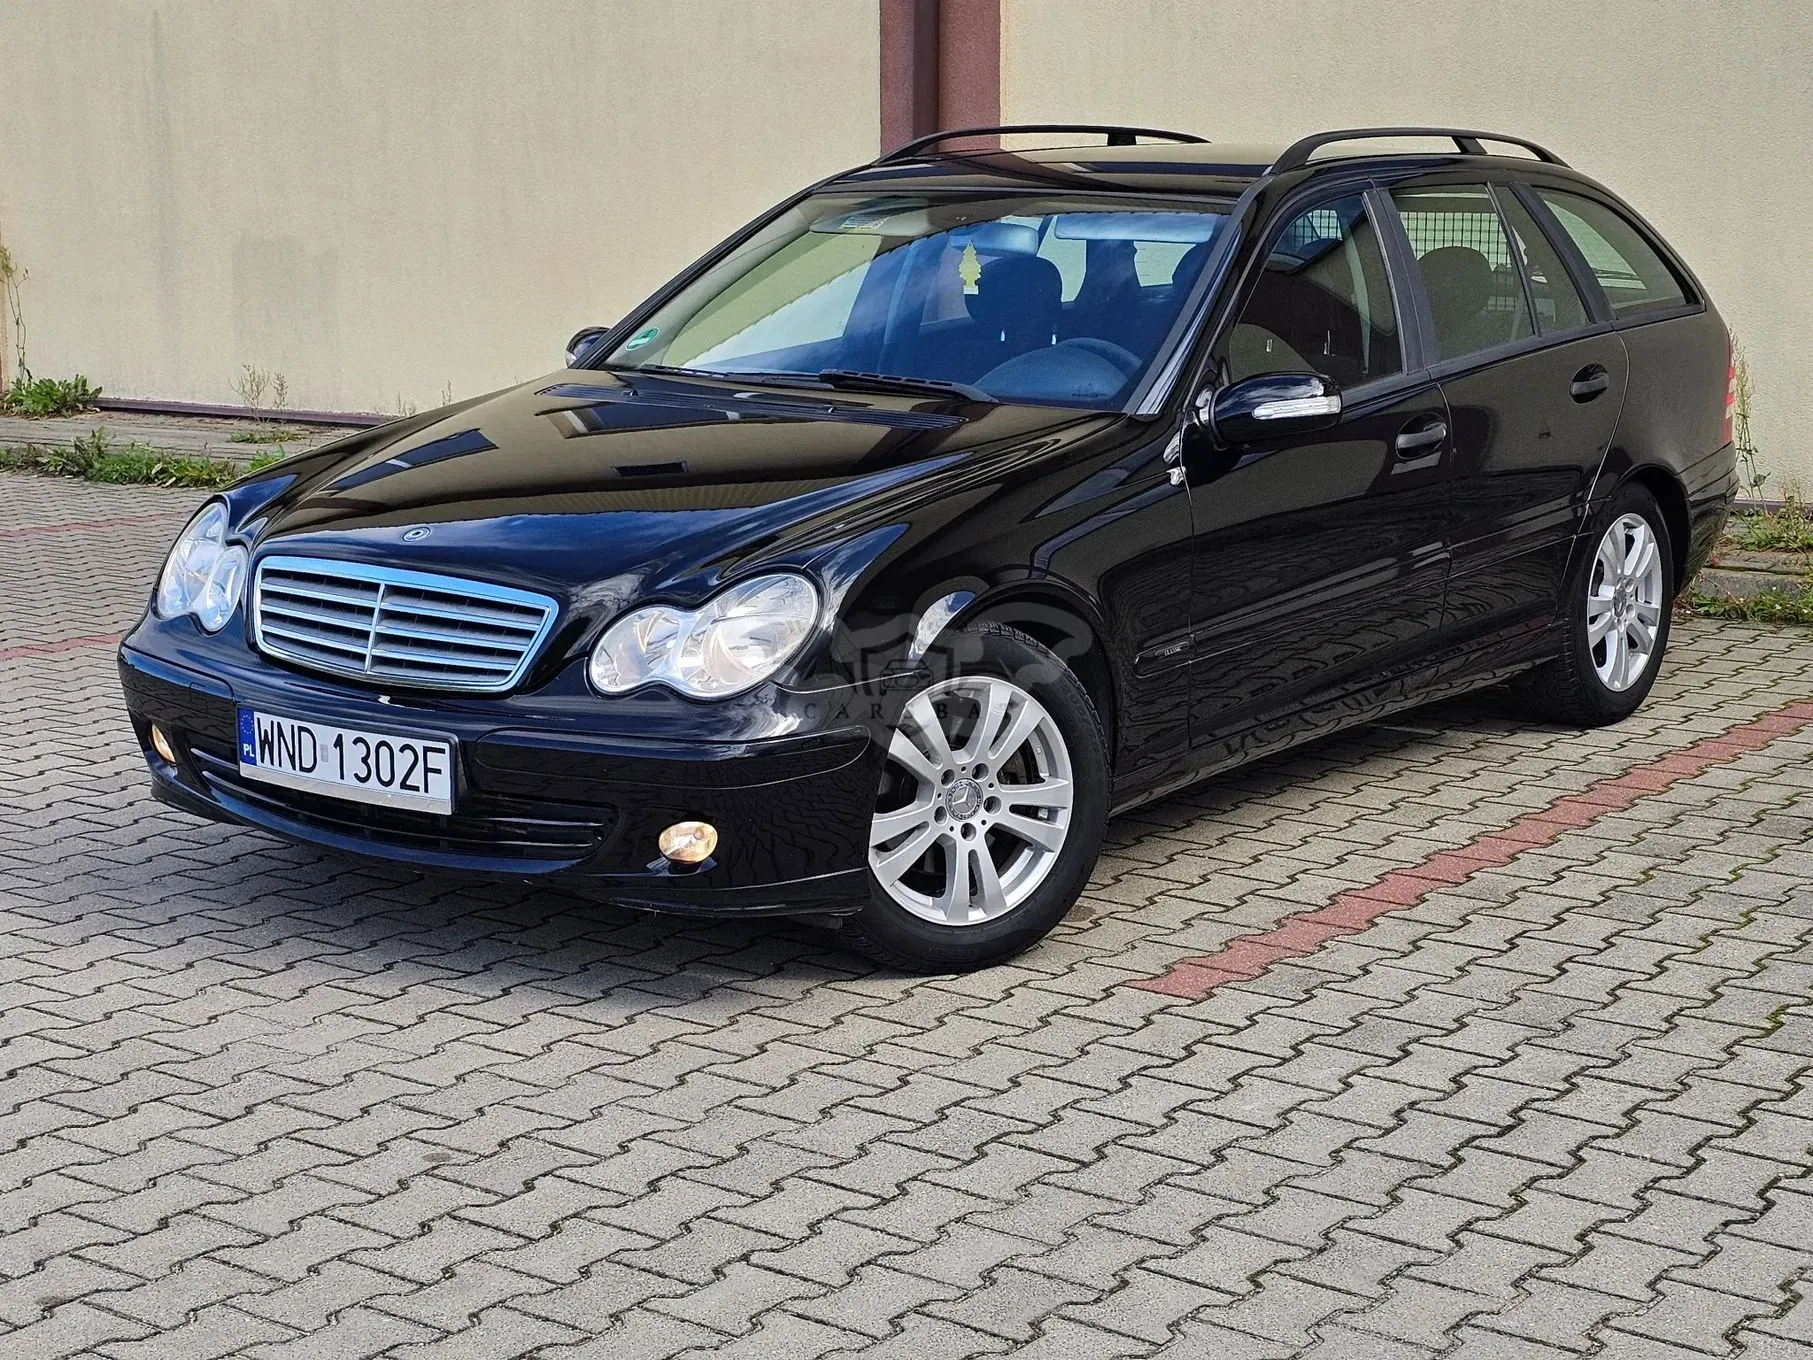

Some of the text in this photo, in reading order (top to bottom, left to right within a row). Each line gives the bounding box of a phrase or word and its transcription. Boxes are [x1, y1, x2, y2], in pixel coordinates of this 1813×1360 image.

[243, 743, 255, 757] PL
[256, 717, 446, 793] WND 1302F
